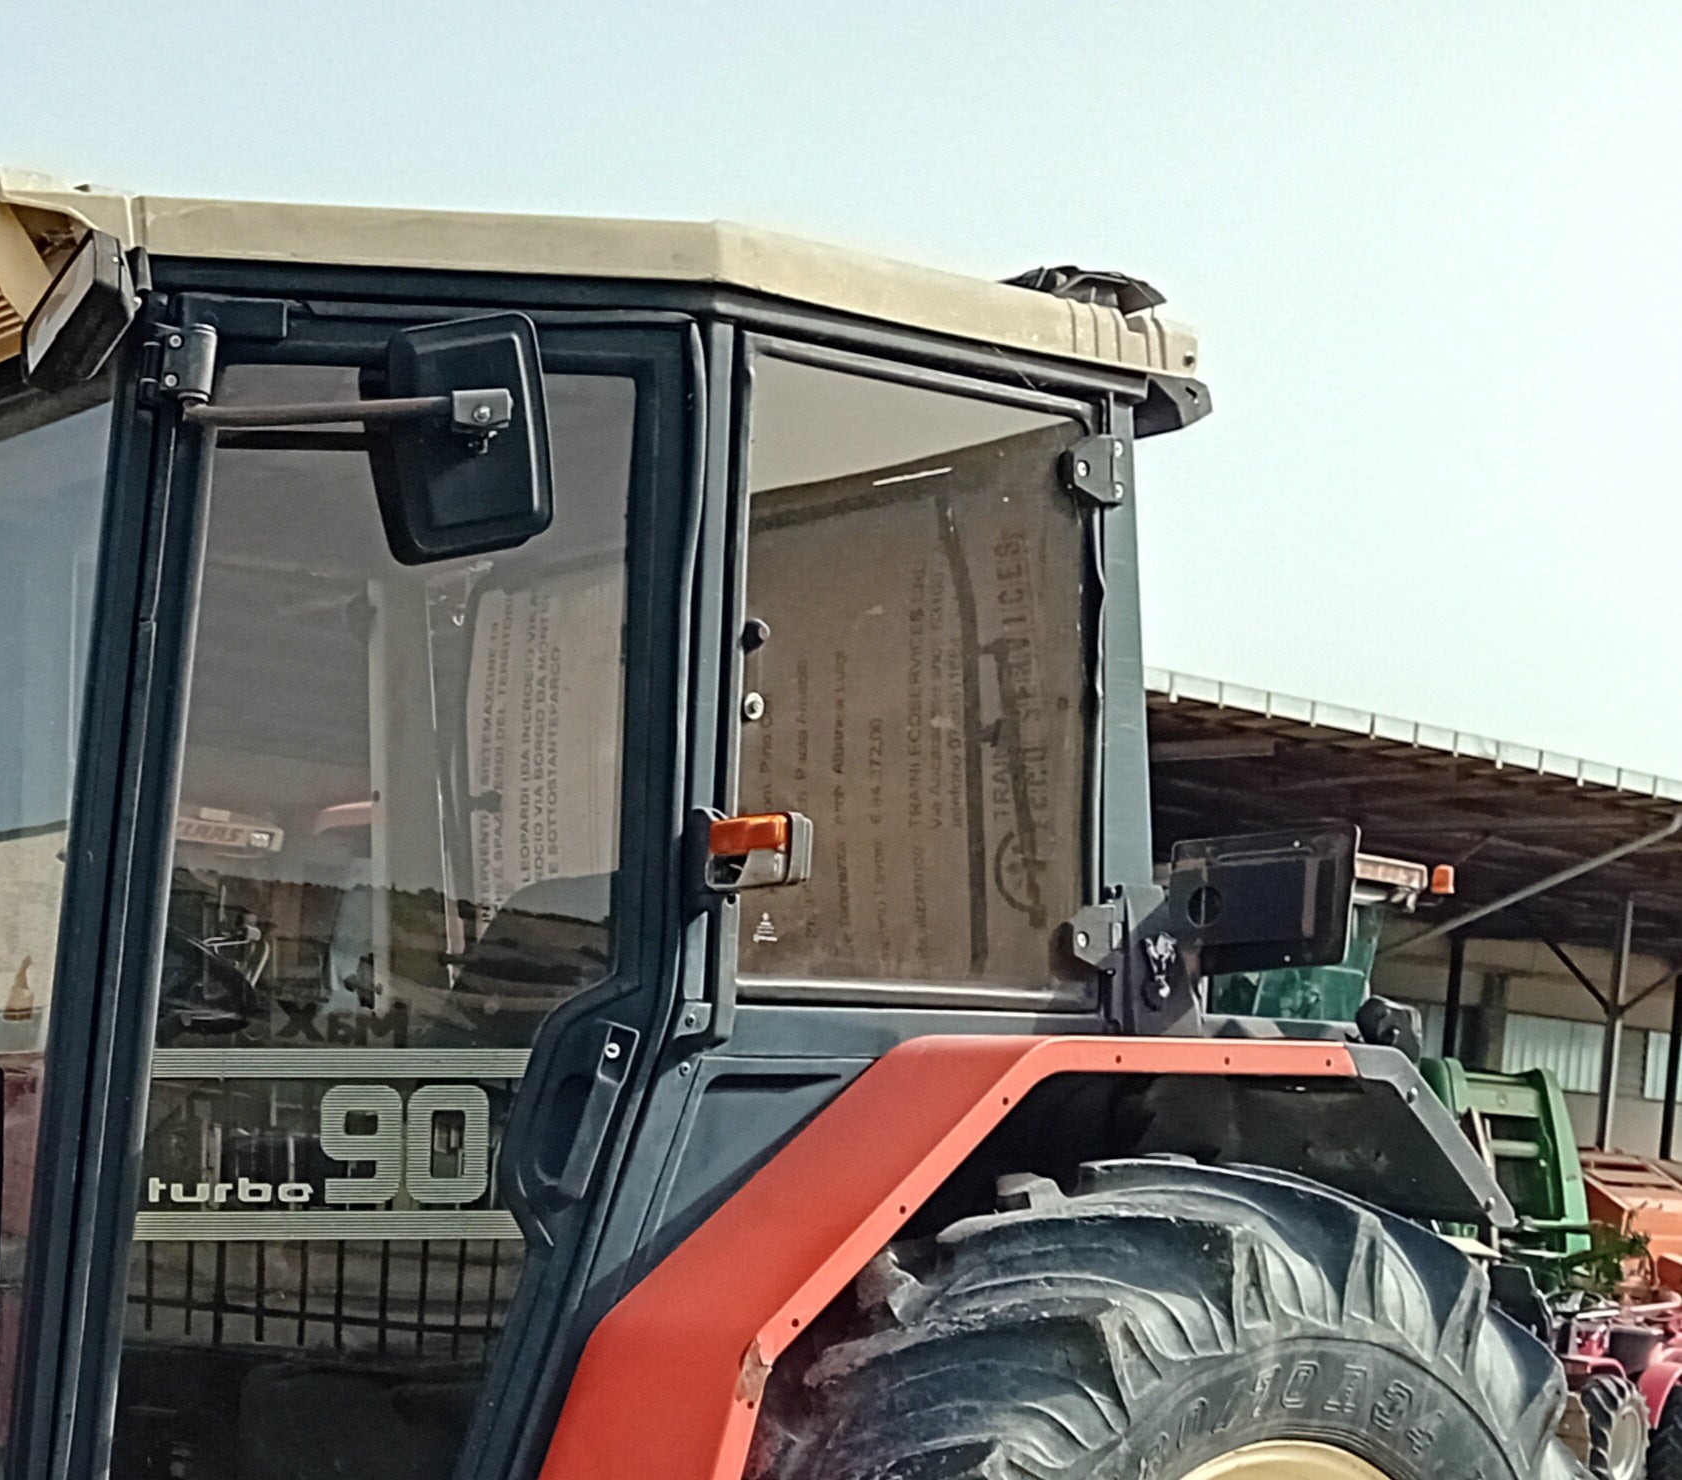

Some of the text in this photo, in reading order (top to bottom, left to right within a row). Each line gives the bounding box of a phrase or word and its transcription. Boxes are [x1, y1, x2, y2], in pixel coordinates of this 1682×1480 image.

[497, 598, 514, 695] TERRITORI
[535, 676, 548, 703] DA
[494, 702, 507, 741] DEL
[533, 709, 546, 780] BORGO
[493, 746, 506, 790] ERDI
[908, 761, 921, 829] TRAINI
[533, 785, 545, 816] VIA
[492, 812, 504, 862] SPAZ
[519, 787, 531, 883] LEOPARDI
[148, 1085, 489, 1204] turbo 90
